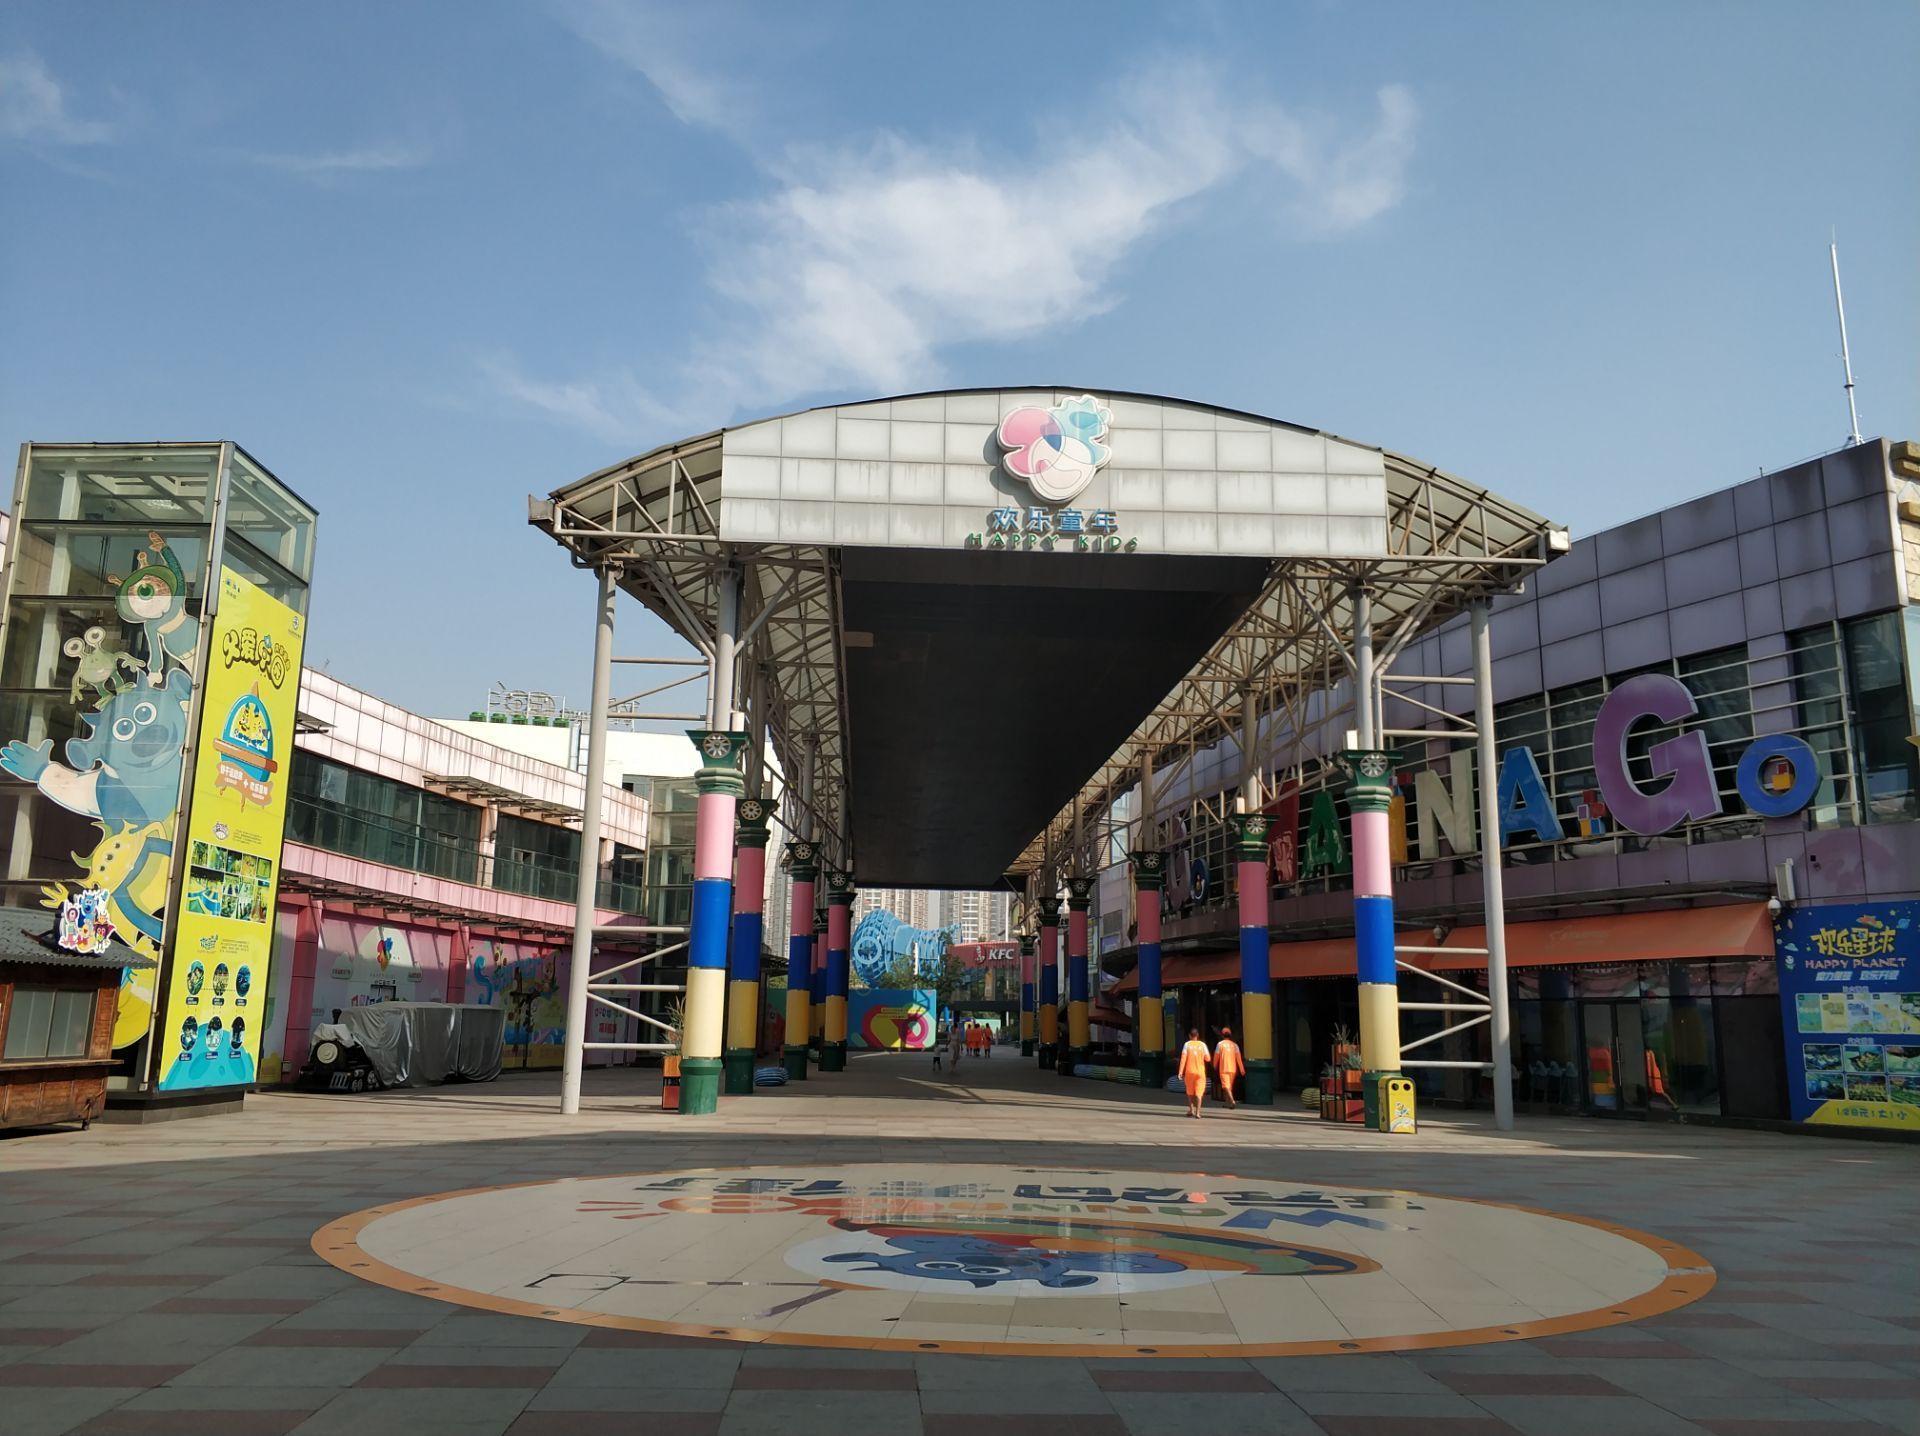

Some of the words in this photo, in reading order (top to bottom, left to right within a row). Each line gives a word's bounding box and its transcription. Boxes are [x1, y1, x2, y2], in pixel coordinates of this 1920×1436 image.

[991, 505, 1119, 533] 欢乐童年
[967, 532, 1060, 548] HAPPY
[1078, 535, 1139, 549] KIDS
[1810, 927, 1896, 957] 欢乐星球
[989, 949, 1014, 960] KFC
[1805, 960, 1848, 969] HAPPY
[1853, 958, 1907, 968] PLANET
